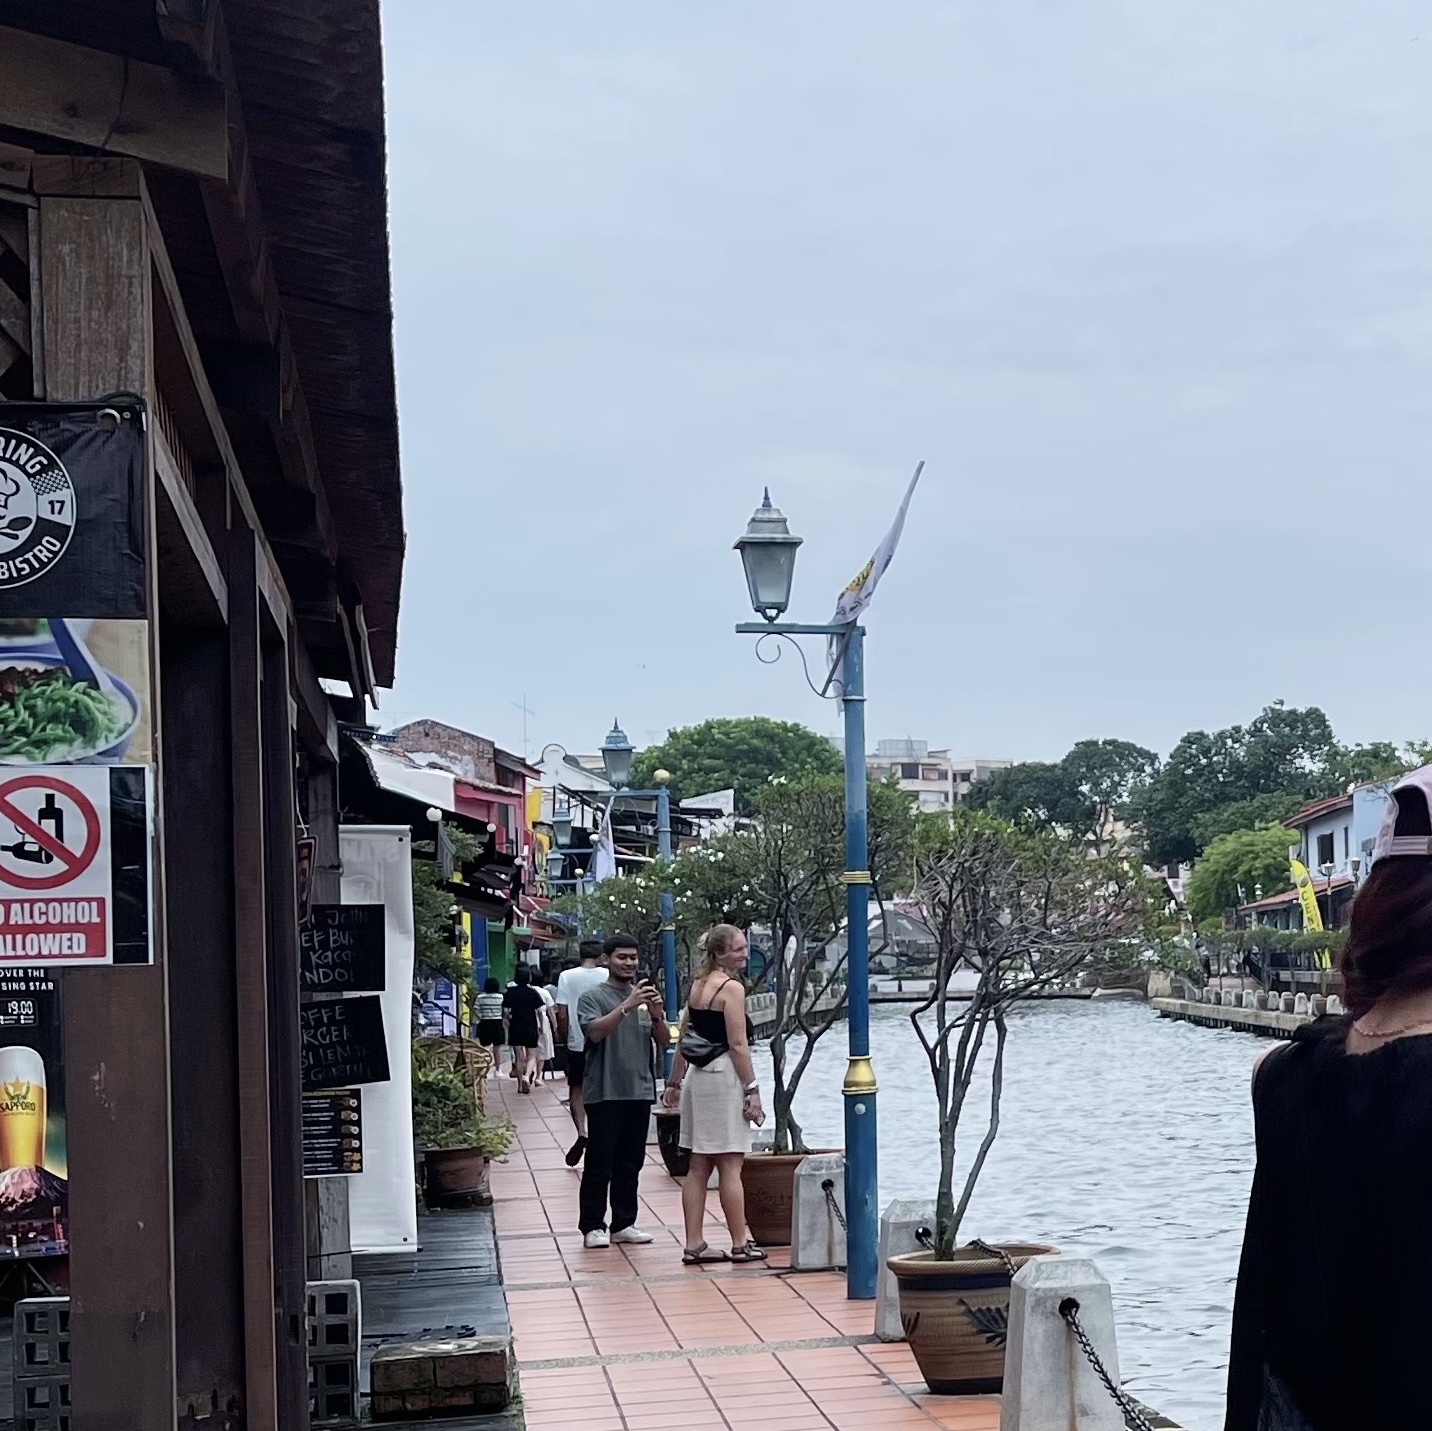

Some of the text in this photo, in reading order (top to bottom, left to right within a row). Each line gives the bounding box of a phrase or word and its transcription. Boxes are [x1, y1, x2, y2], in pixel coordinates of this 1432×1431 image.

[48, 500, 66, 516] 17
[0, 536, 61, 580] BISTRO
[9, 901, 101, 925] ALCOHOL
[28, 969, 45, 978] THE
[29, 981, 54, 991] STAR
